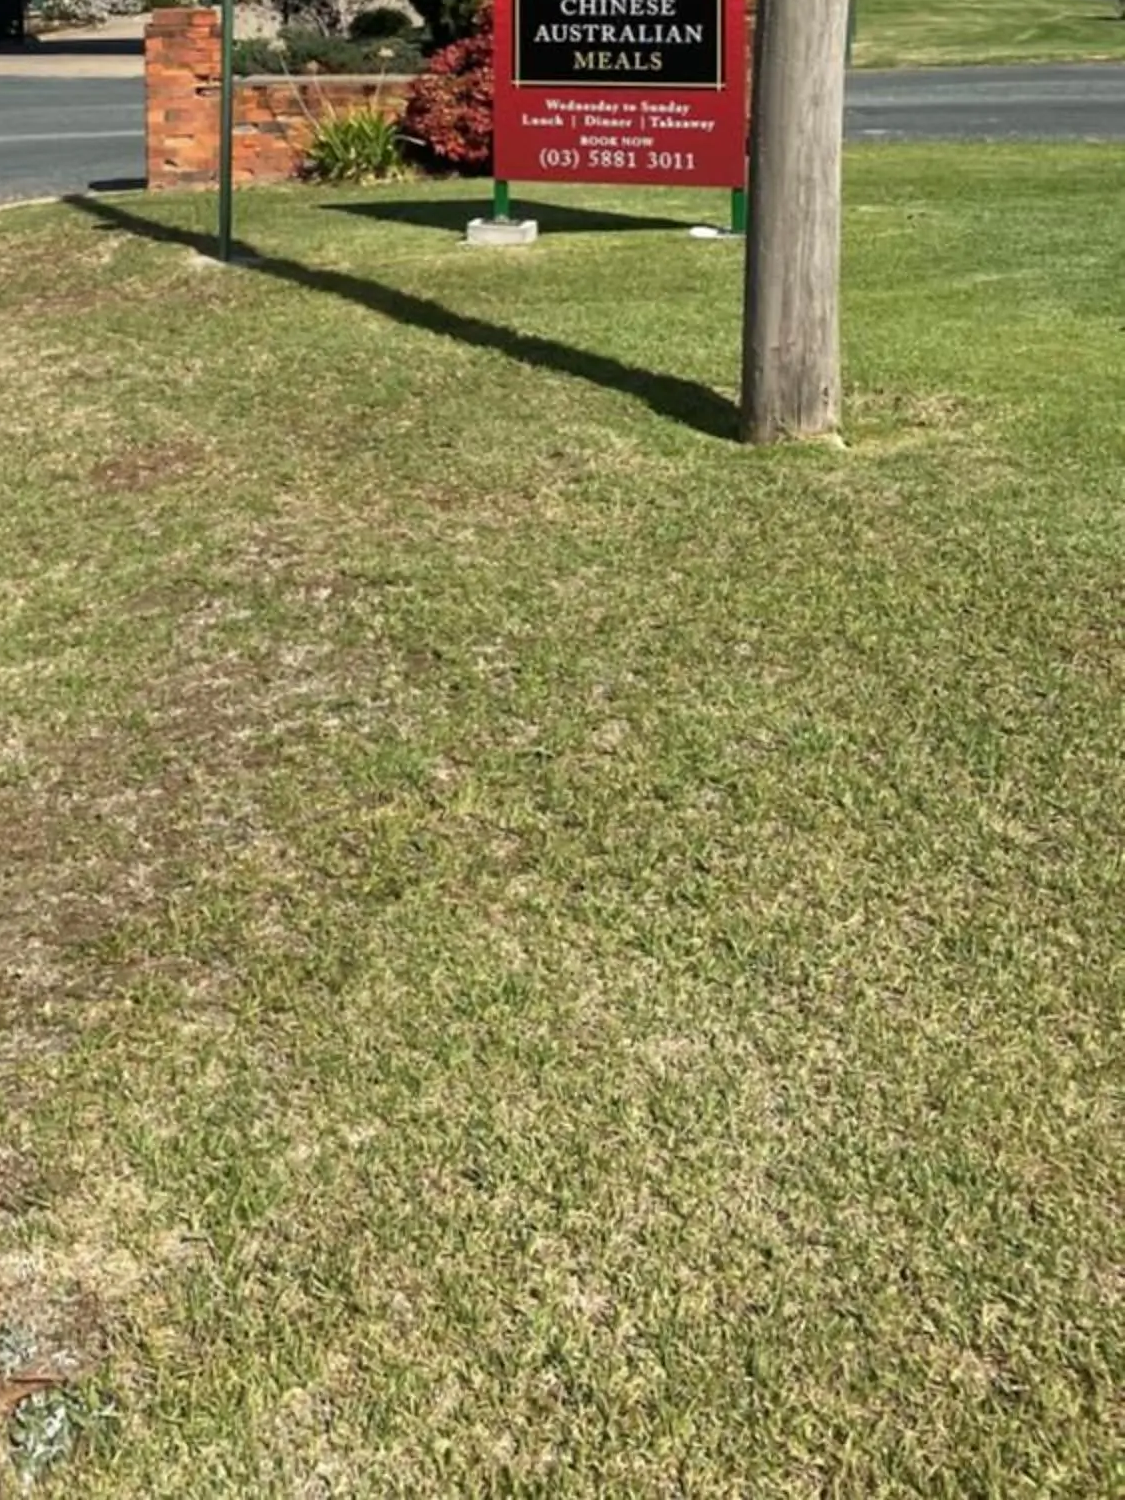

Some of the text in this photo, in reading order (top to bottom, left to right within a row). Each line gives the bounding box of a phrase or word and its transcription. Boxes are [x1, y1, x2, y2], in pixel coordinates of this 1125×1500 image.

[533, 23, 703, 43] AUSTRALIAN
[573, 51, 663, 71] MEALS
[544, 99, 691, 116] Wednesday to Sunday
[522, 113, 716, 132] Lunch Dinner Takeaway
[579, 135, 654, 147] BOOK NOW
[538, 148, 696, 170] (03) 5881 3011
